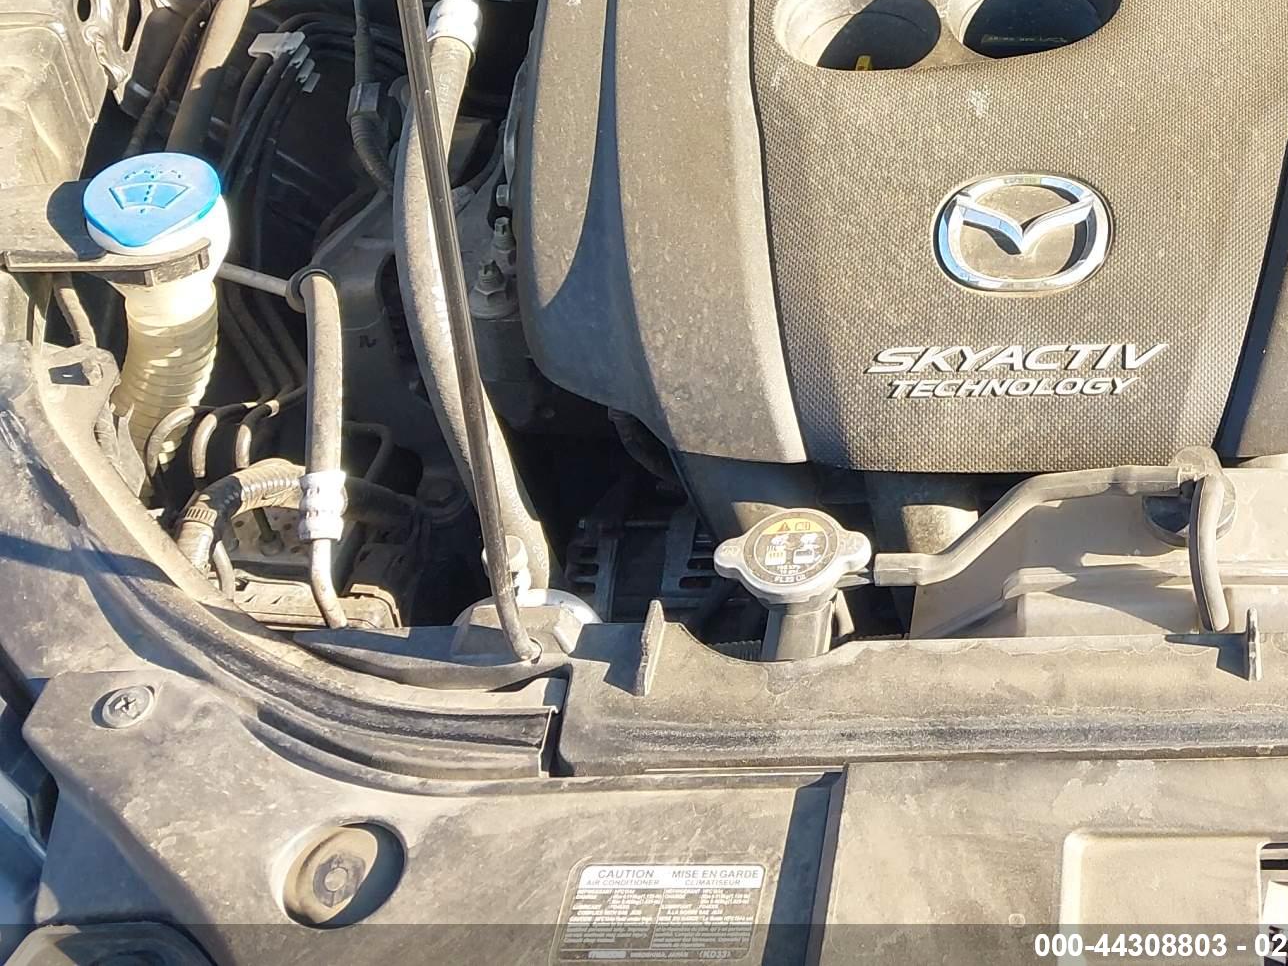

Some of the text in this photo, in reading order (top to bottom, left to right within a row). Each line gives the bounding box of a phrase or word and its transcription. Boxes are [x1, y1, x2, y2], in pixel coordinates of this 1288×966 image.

[864, 343, 1169, 373] SKYACTIV
[886, 377, 1140, 399] TECHNOLOGY
[598, 869, 655, 879] CAUTION
[671, 869, 759, 879] MISE EN GARDE
